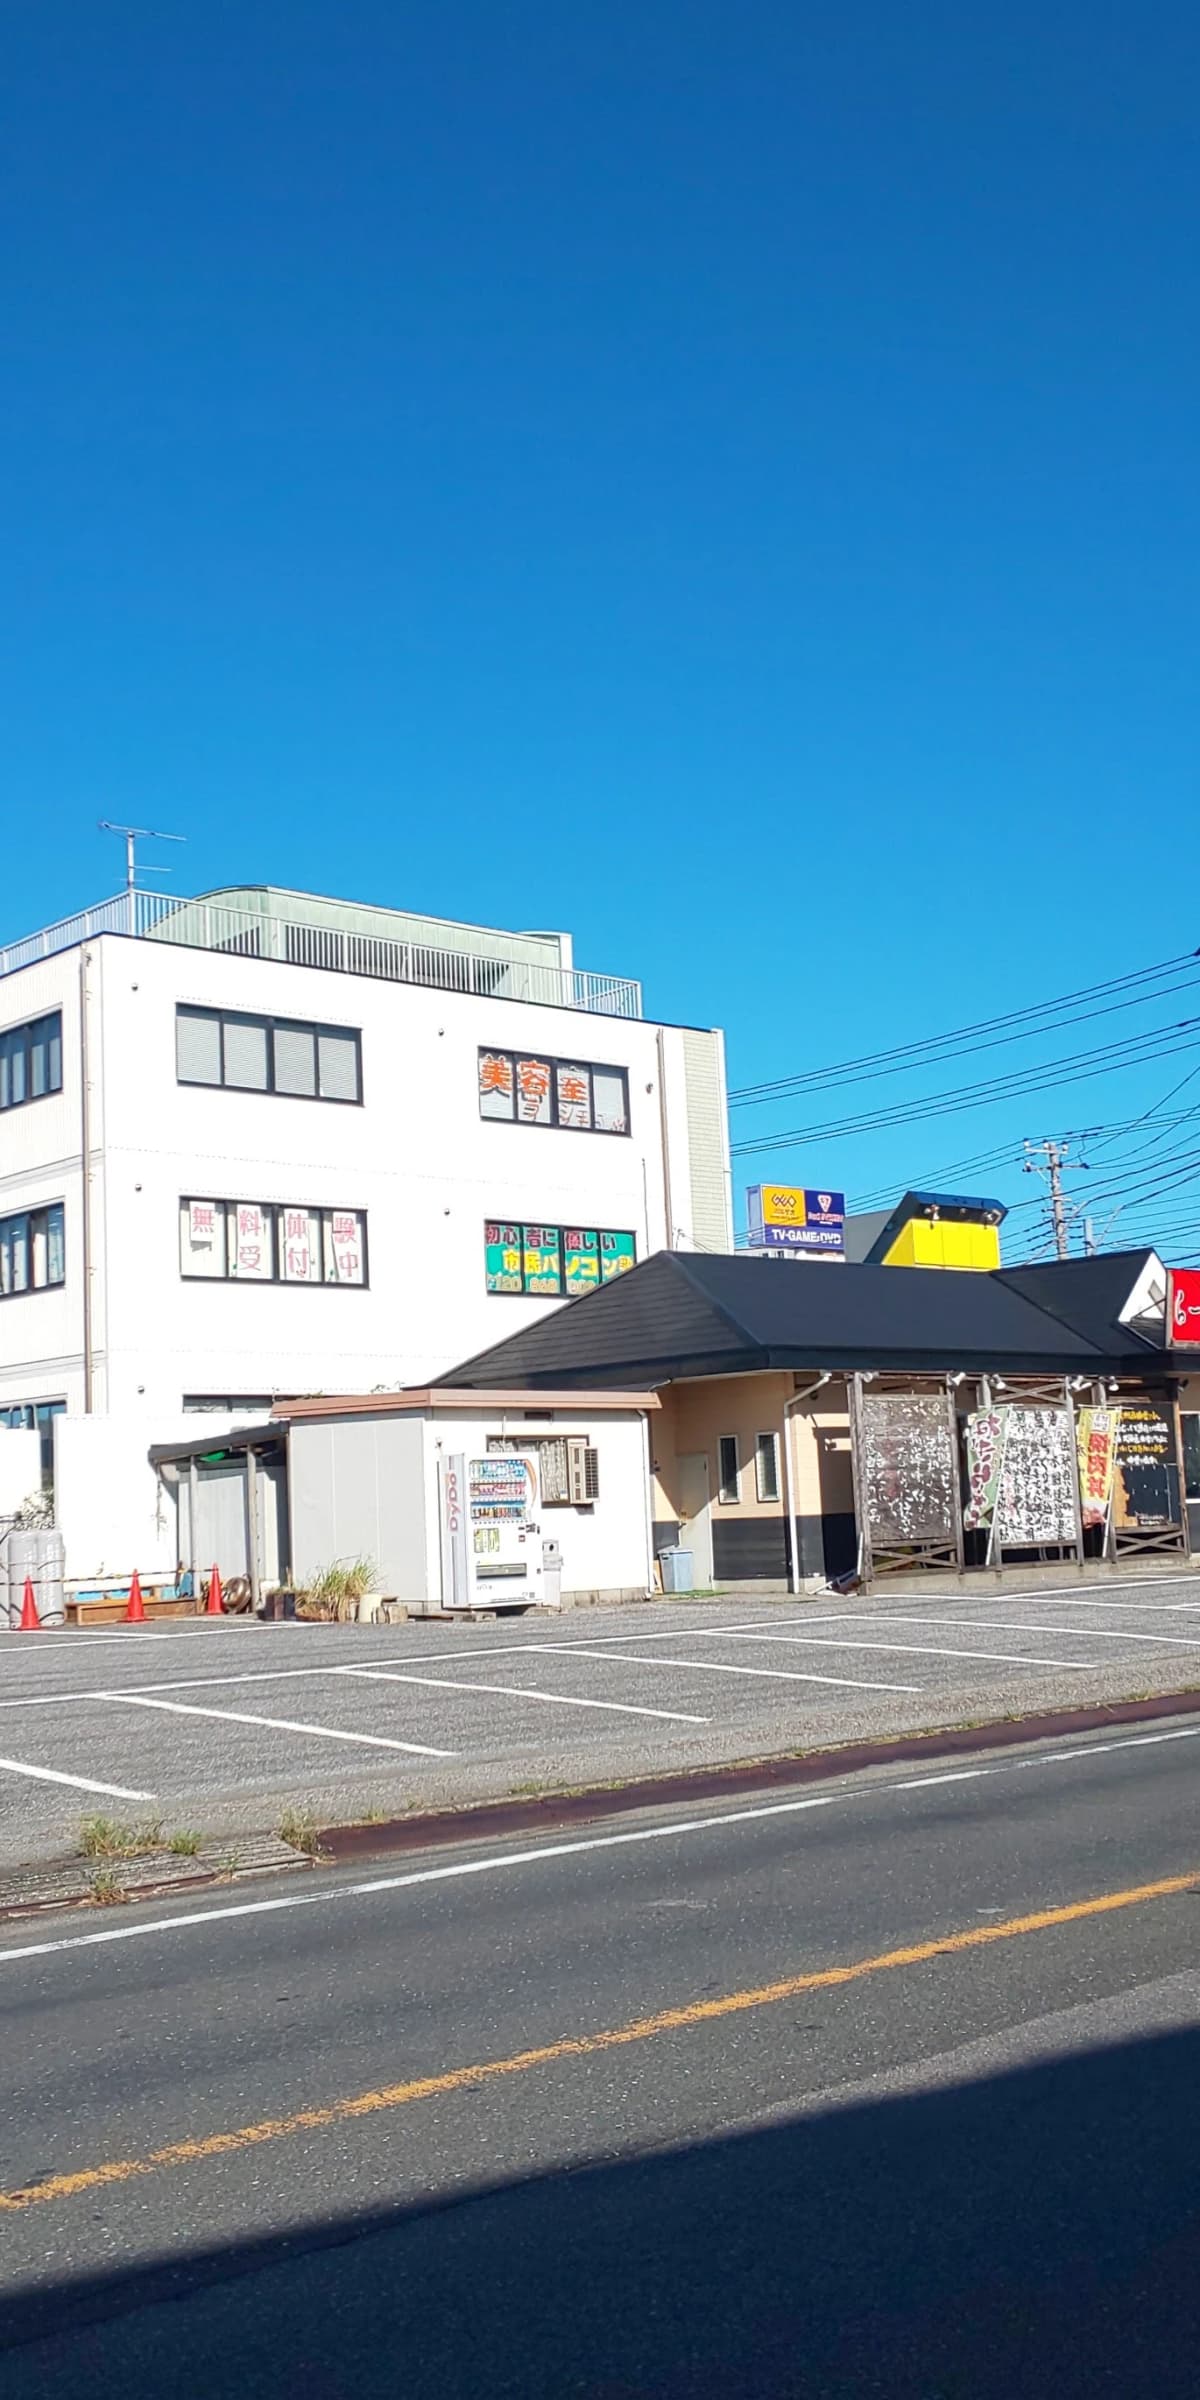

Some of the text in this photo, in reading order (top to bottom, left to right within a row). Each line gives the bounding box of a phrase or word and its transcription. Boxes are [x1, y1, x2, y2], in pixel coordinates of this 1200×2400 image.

[192, 1206, 357, 1244] 無料体験
[486, 1224, 616, 1250] 初心者に優しい
[239, 1245, 359, 1278] 受付中
